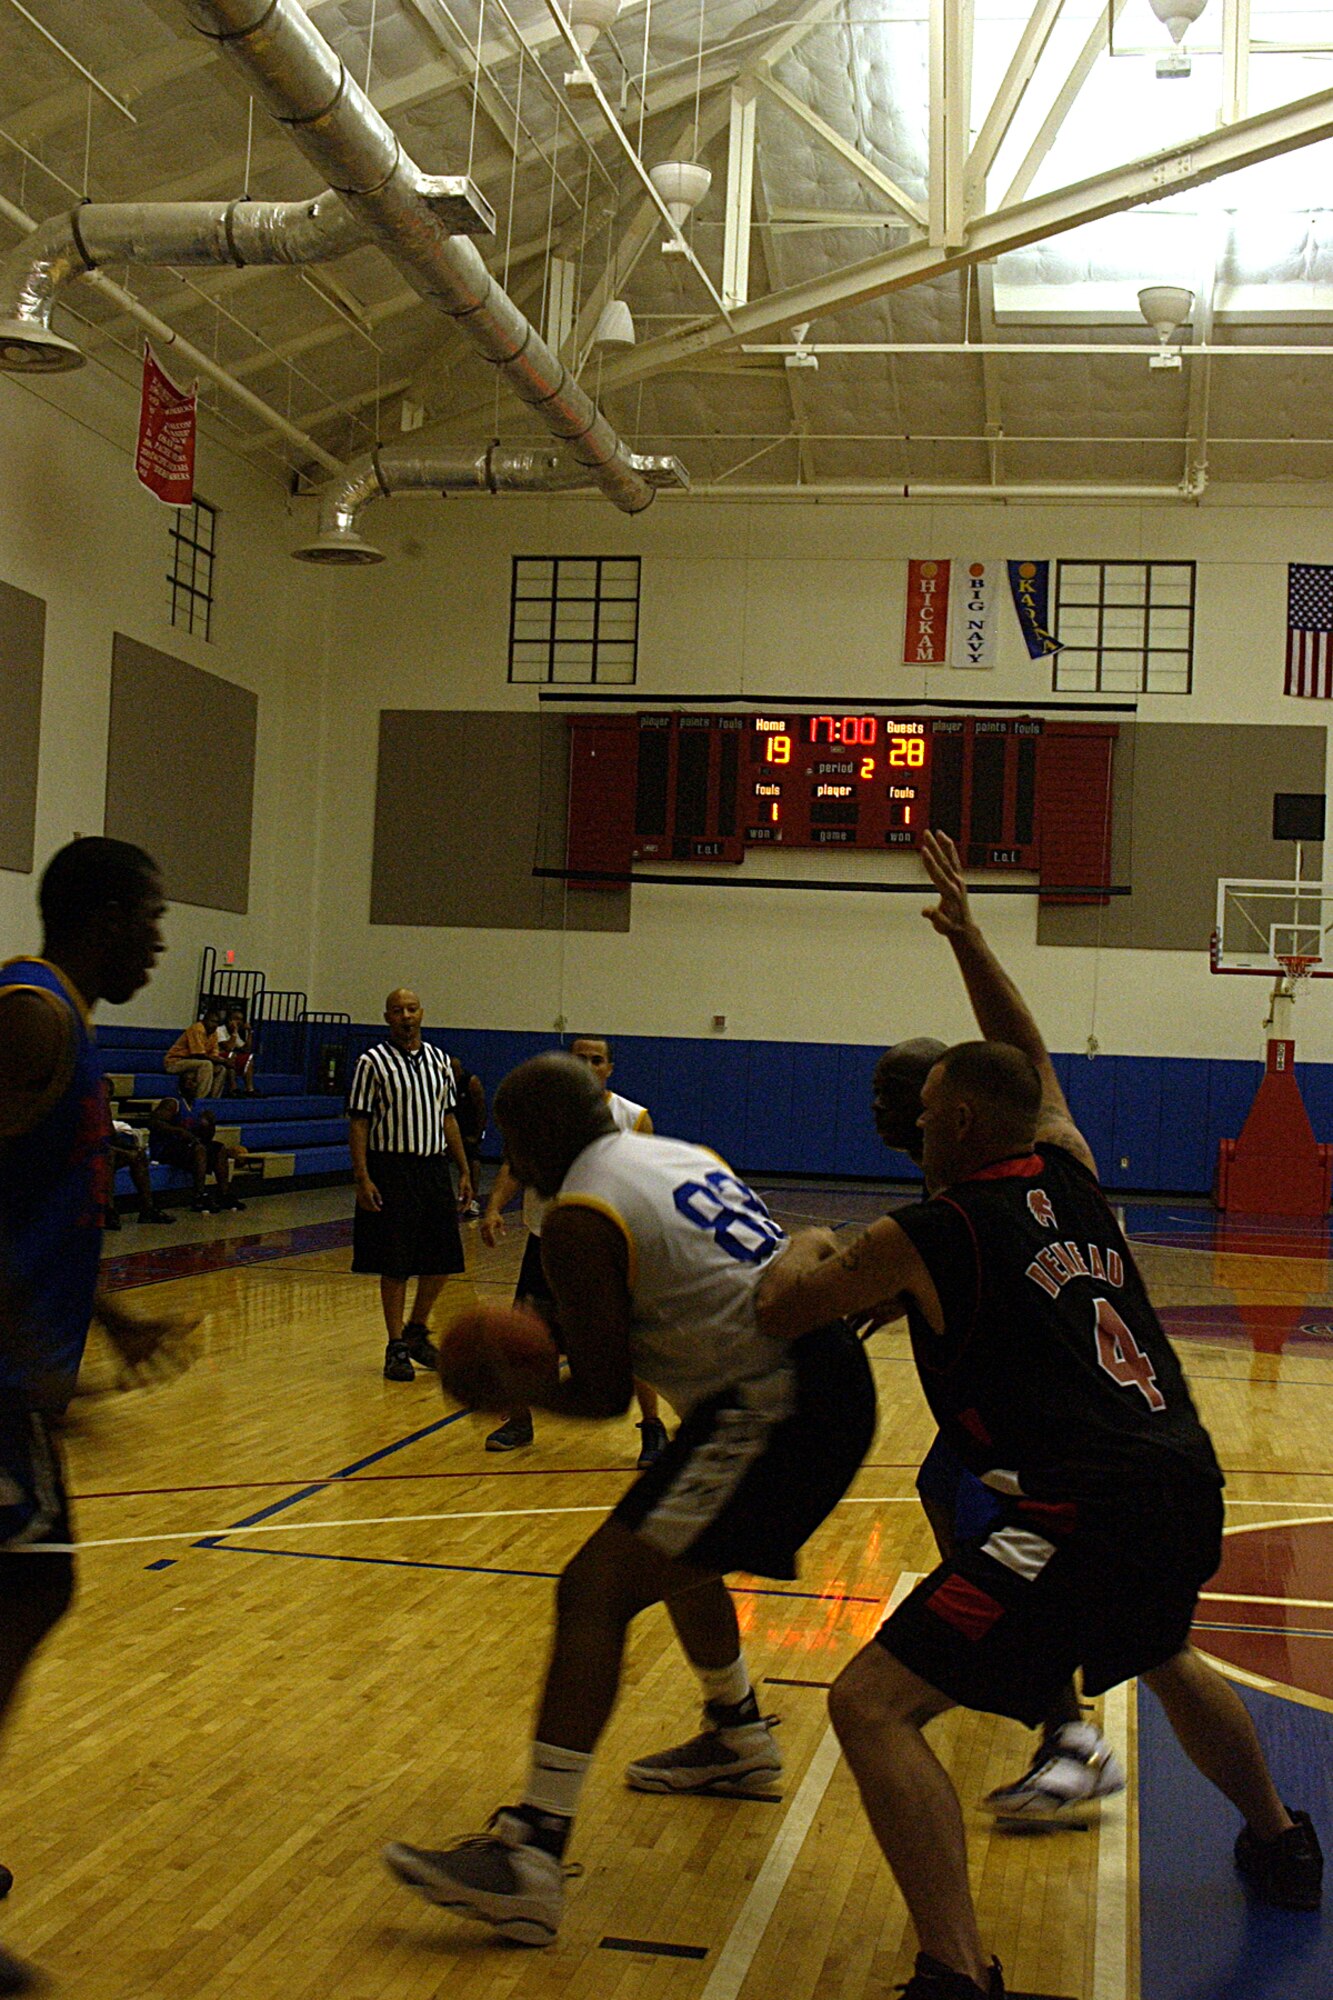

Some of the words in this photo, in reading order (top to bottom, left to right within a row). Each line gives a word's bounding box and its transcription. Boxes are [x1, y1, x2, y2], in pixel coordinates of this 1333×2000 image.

[967, 579, 985, 611] BIG
[916, 579, 938, 661] HICKAM
[967, 620, 985, 663] NAVY
[641, 716, 670, 729] player
[719, 717, 743, 729] fouls
[755, 718, 786, 731] Home
[887, 720, 924, 734] Guests
[975, 721, 1007, 733] points
[1015, 723, 1040, 734] fouls
[809, 716, 877, 745] 17:00
[766, 736, 791, 764] 19
[889, 738, 925, 766] 28
[819, 762, 853, 774] period
[860, 758, 875, 779] 2
[755, 783, 781, 796] fouls
[817, 784, 852, 797] player
[889, 786, 915, 799] fouls
[771, 802, 779, 821] 1
[904, 806, 911, 824] 1
[749, 829, 771, 839] won
[820, 830, 847, 841] game
[890, 832, 911, 841] won
[1092, 1297, 1167, 1412] 4
